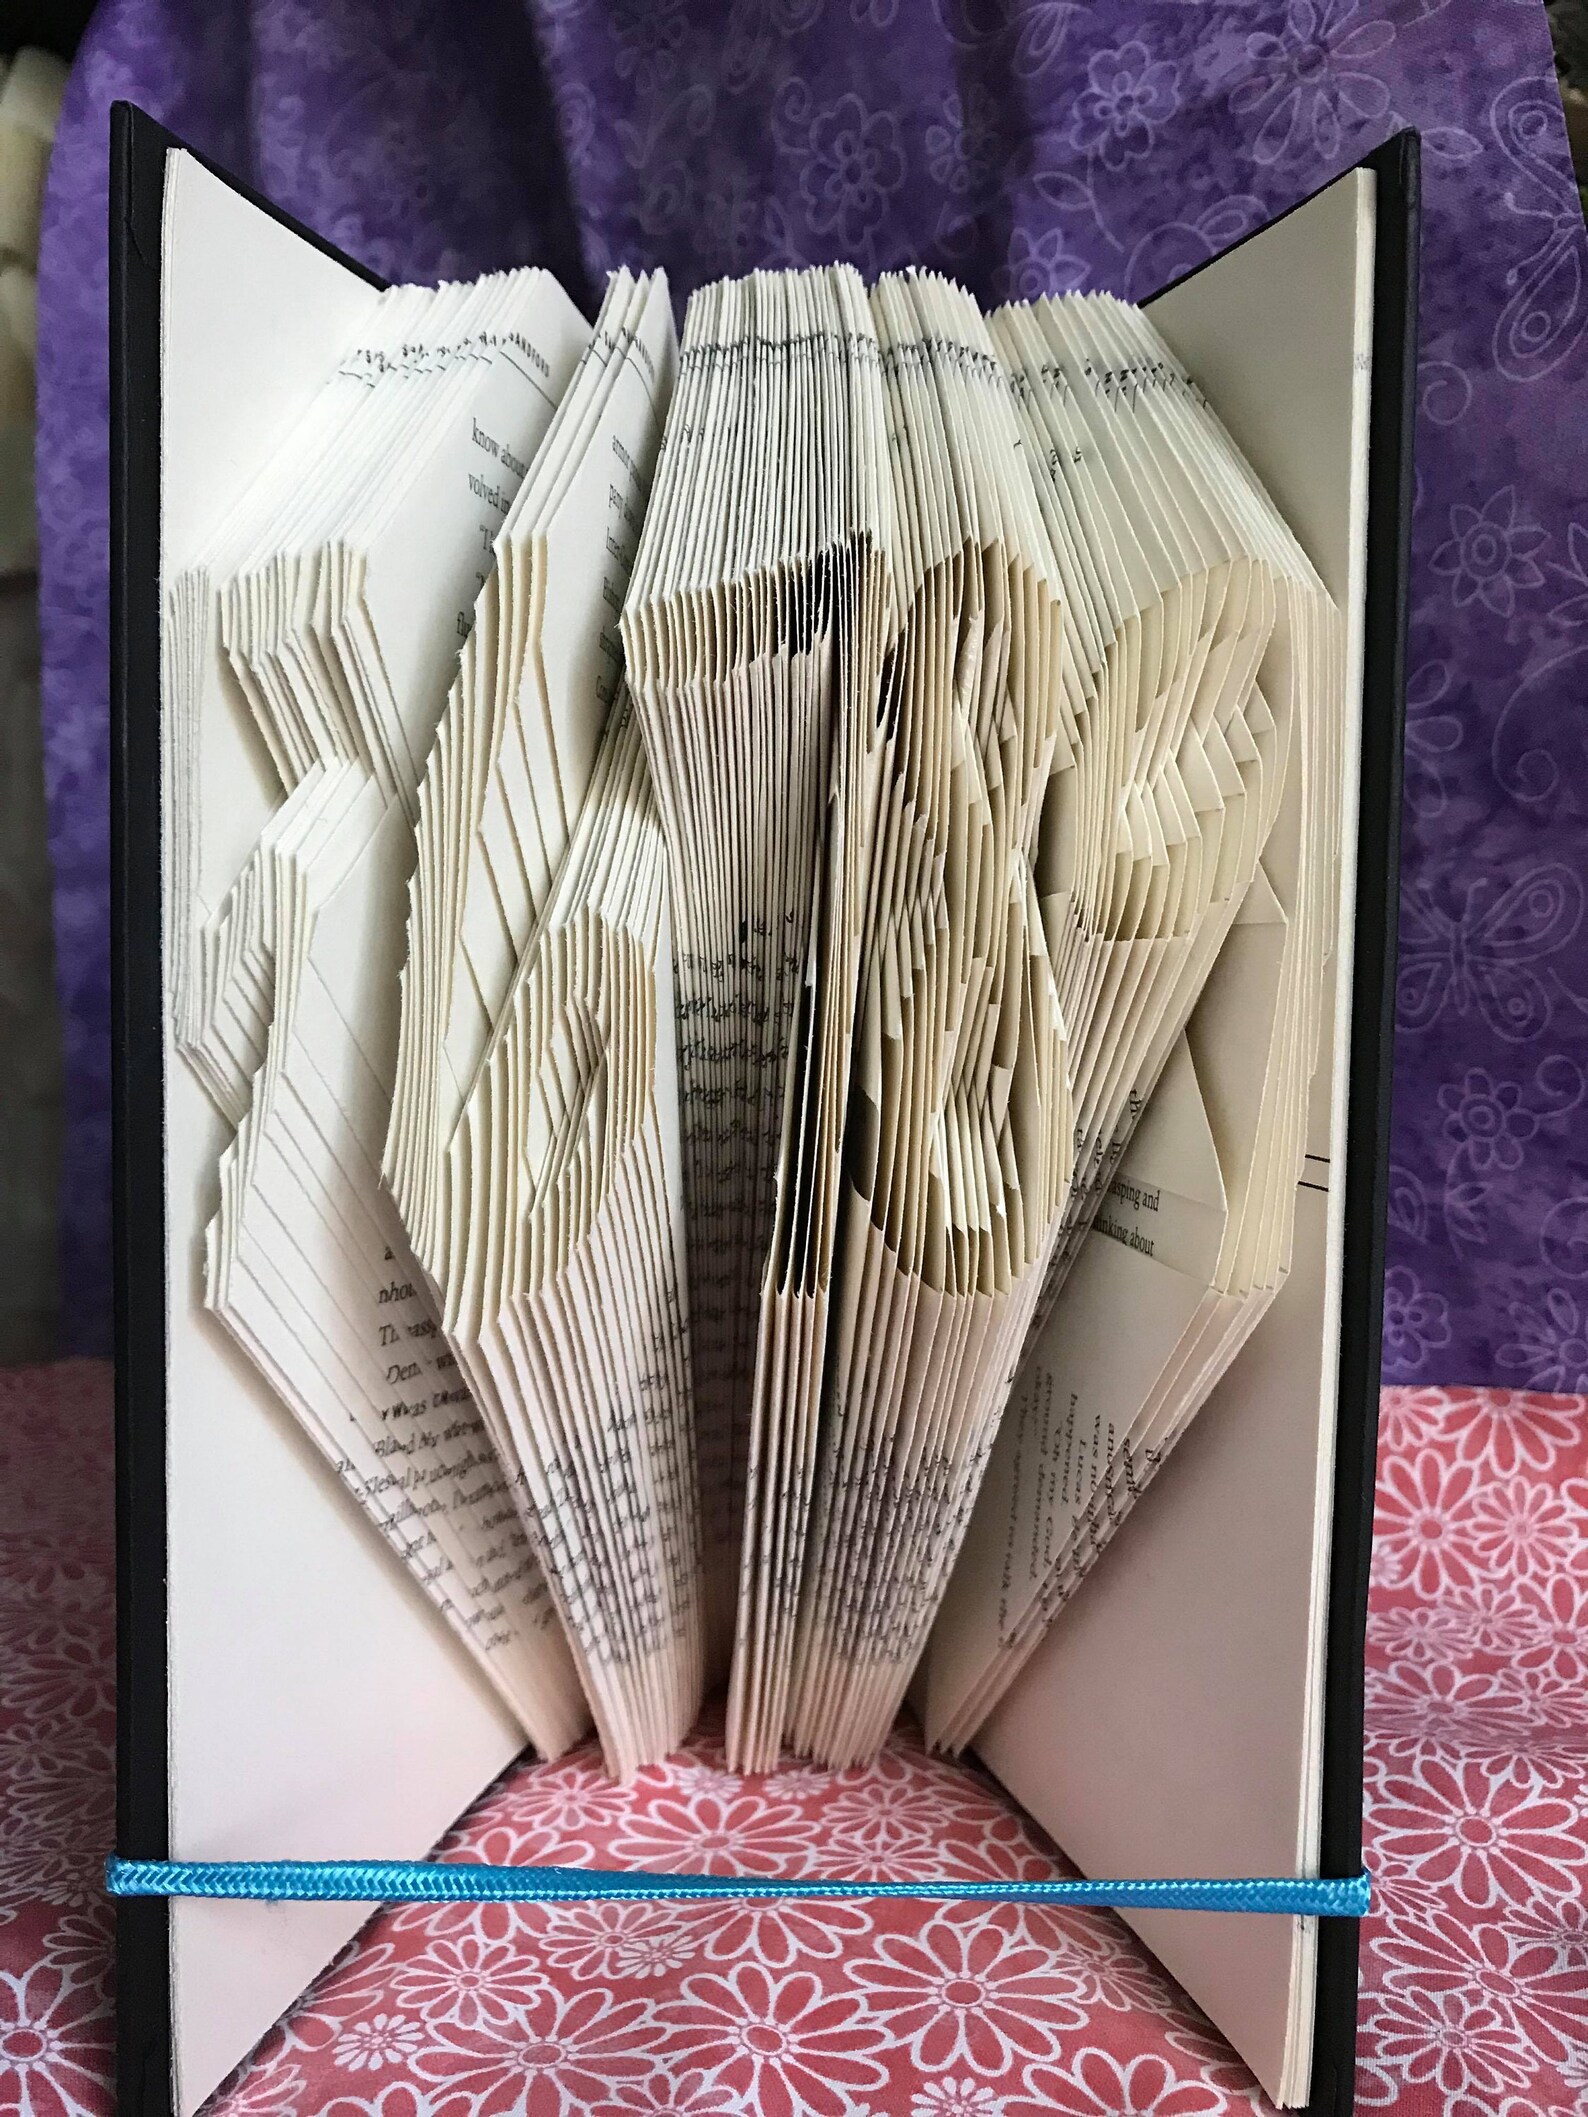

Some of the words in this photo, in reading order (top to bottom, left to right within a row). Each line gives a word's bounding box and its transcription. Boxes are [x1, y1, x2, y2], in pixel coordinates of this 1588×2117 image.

[471, 417, 500, 458] know
[501, 444, 529, 479] abou
[468, 472, 500, 509] volved
[1108, 1180, 1141, 1210] asping
[1142, 1189, 1160, 1212] and
[1129, 1226, 1154, 1257] about
[1075, 1439, 1087, 1504] Lucas
